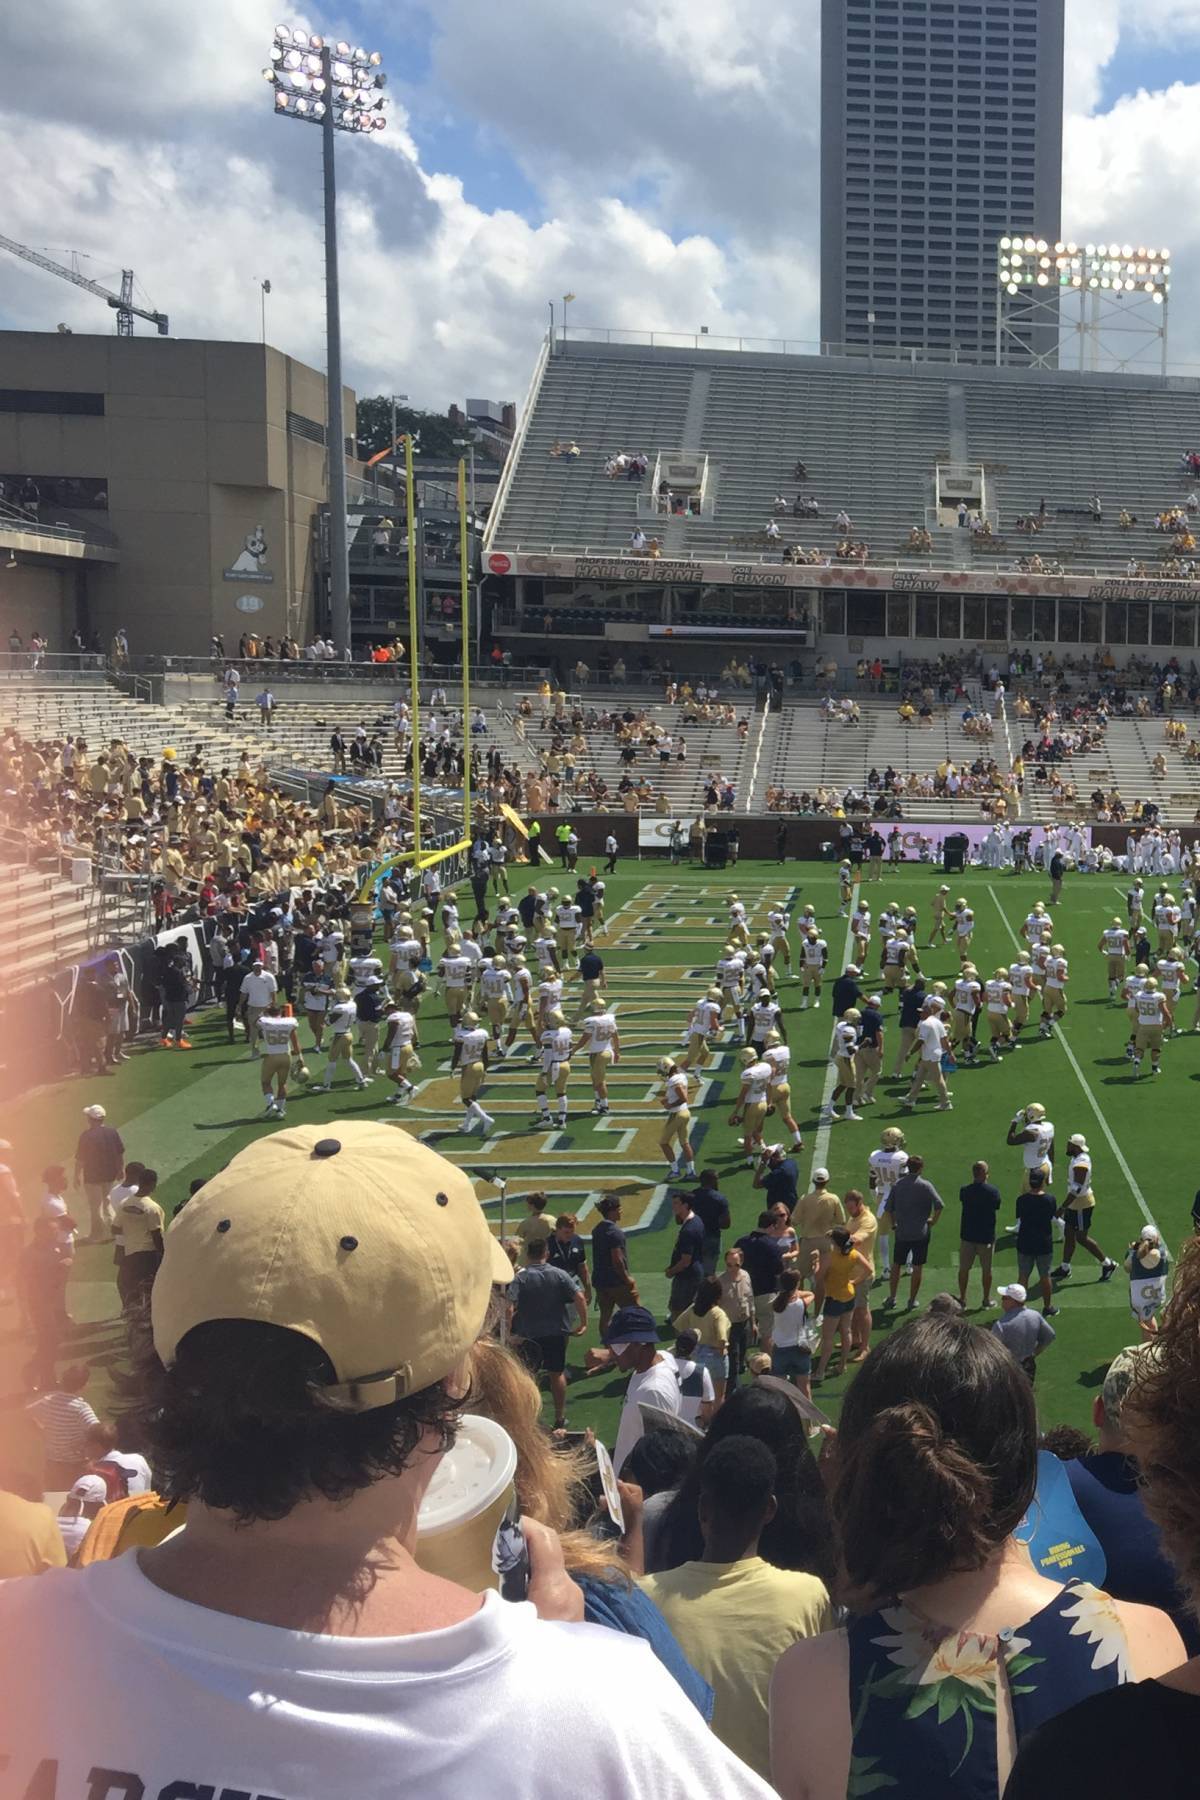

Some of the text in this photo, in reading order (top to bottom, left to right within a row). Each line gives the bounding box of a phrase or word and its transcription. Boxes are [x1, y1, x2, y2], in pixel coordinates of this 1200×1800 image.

[575, 557, 702, 569] PROFESSIONAL FOOTBALL
[575, 565, 704, 582] HALL OF FAME
[732, 566, 752, 574] JOE
[733, 573, 787, 585] GUYON
[893, 579, 939, 590] SHAW
[1104, 579, 1192, 588] COLLEGE FOOTBALL
[1088, 586, 1131, 600] HALL
[1134, 587, 1157, 601] OF
